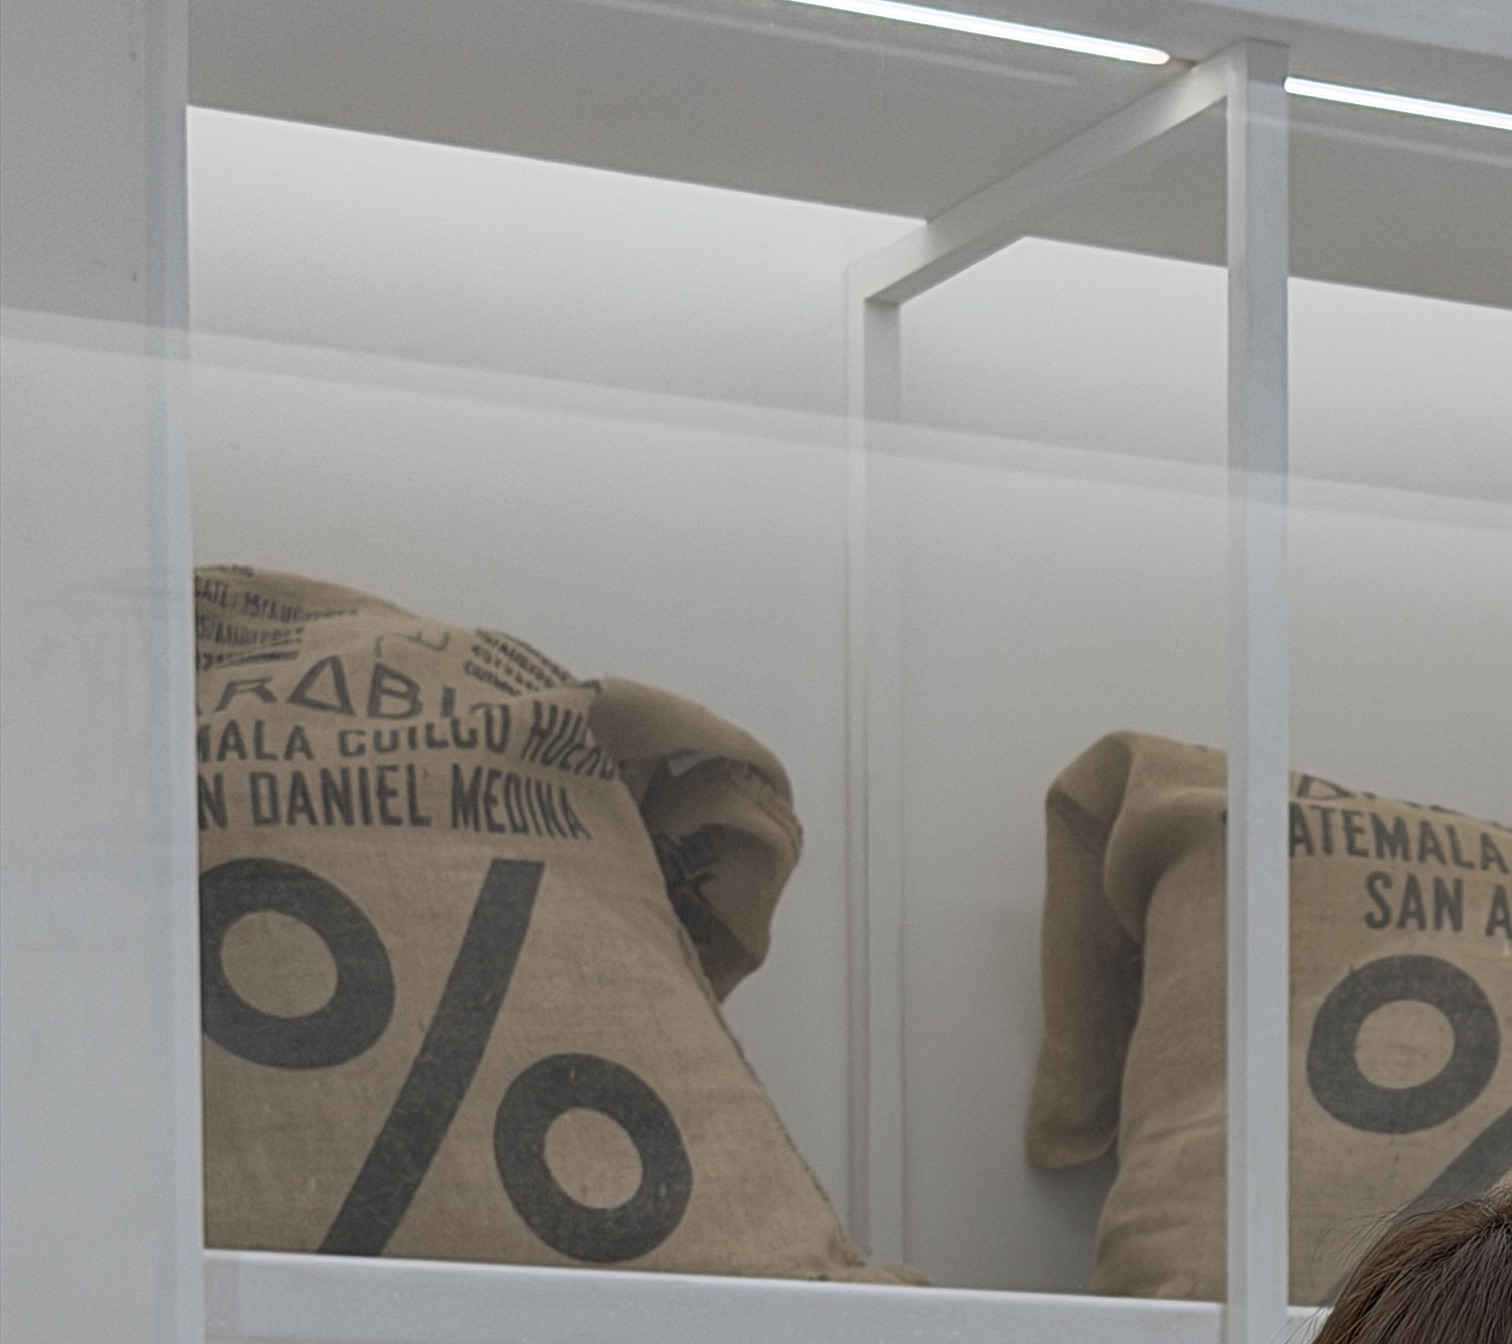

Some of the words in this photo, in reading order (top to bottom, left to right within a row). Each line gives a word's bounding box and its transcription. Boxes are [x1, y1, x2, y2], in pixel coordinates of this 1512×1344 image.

[250, 763, 433, 831] DANIEL
[450, 762, 594, 842] MEDINA
[1364, 870, 1465, 933] SAN
